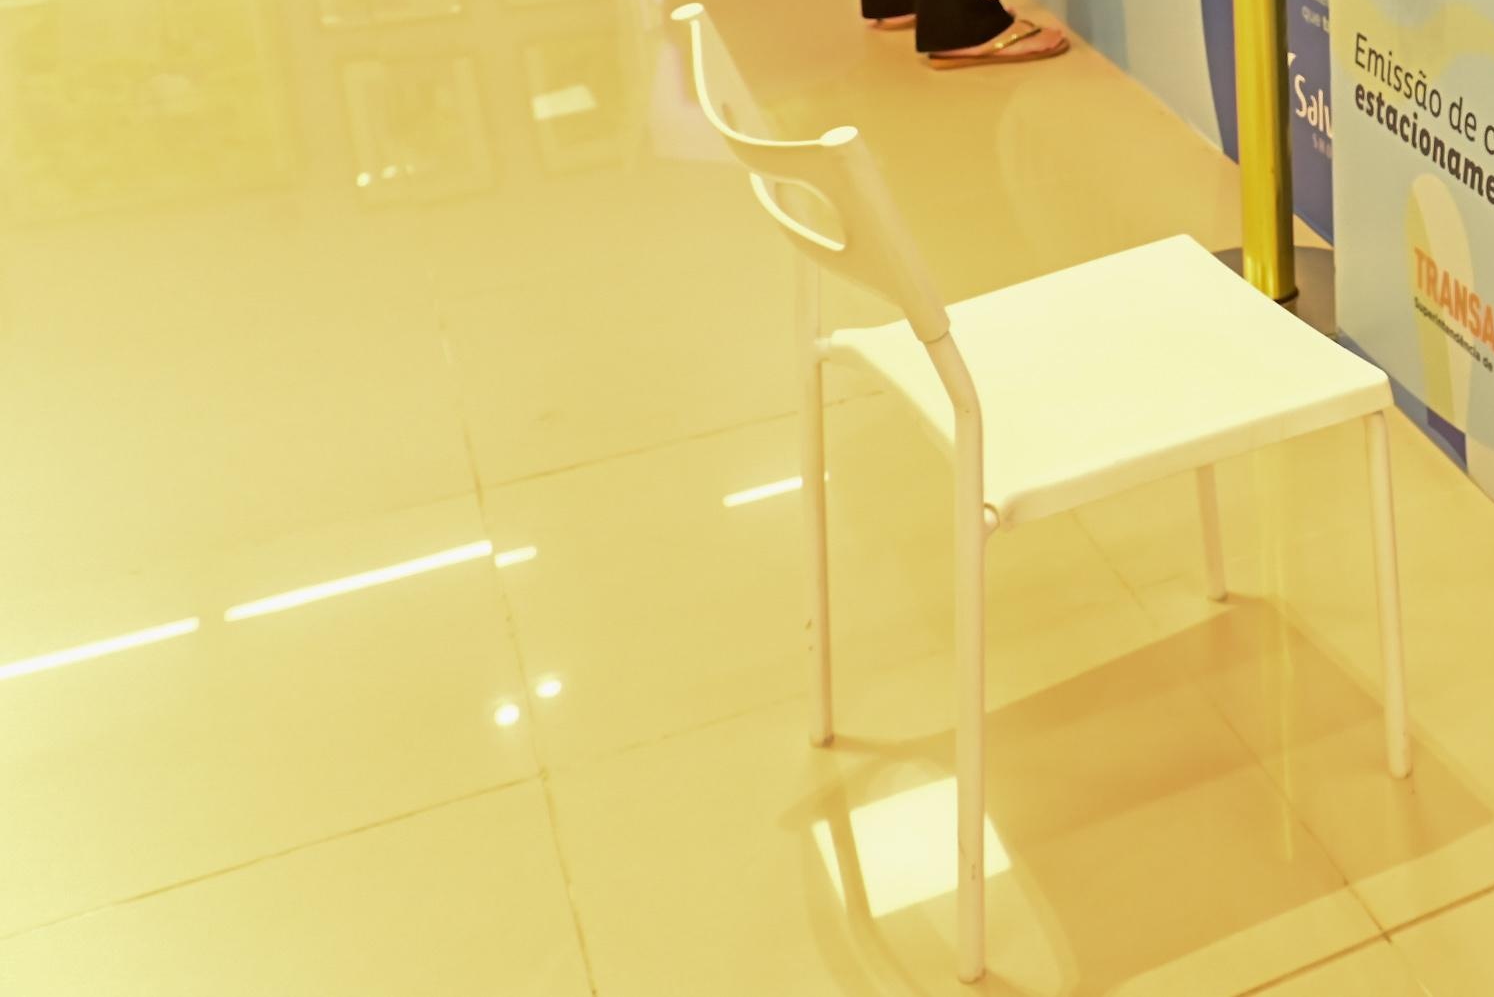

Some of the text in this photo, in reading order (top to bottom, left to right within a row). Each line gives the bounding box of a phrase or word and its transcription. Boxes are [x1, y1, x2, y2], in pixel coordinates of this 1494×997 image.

[1354, 31, 1443, 119] Emissão
[1448, 96, 1477, 141] de
[1482, 356, 1494, 374] de
